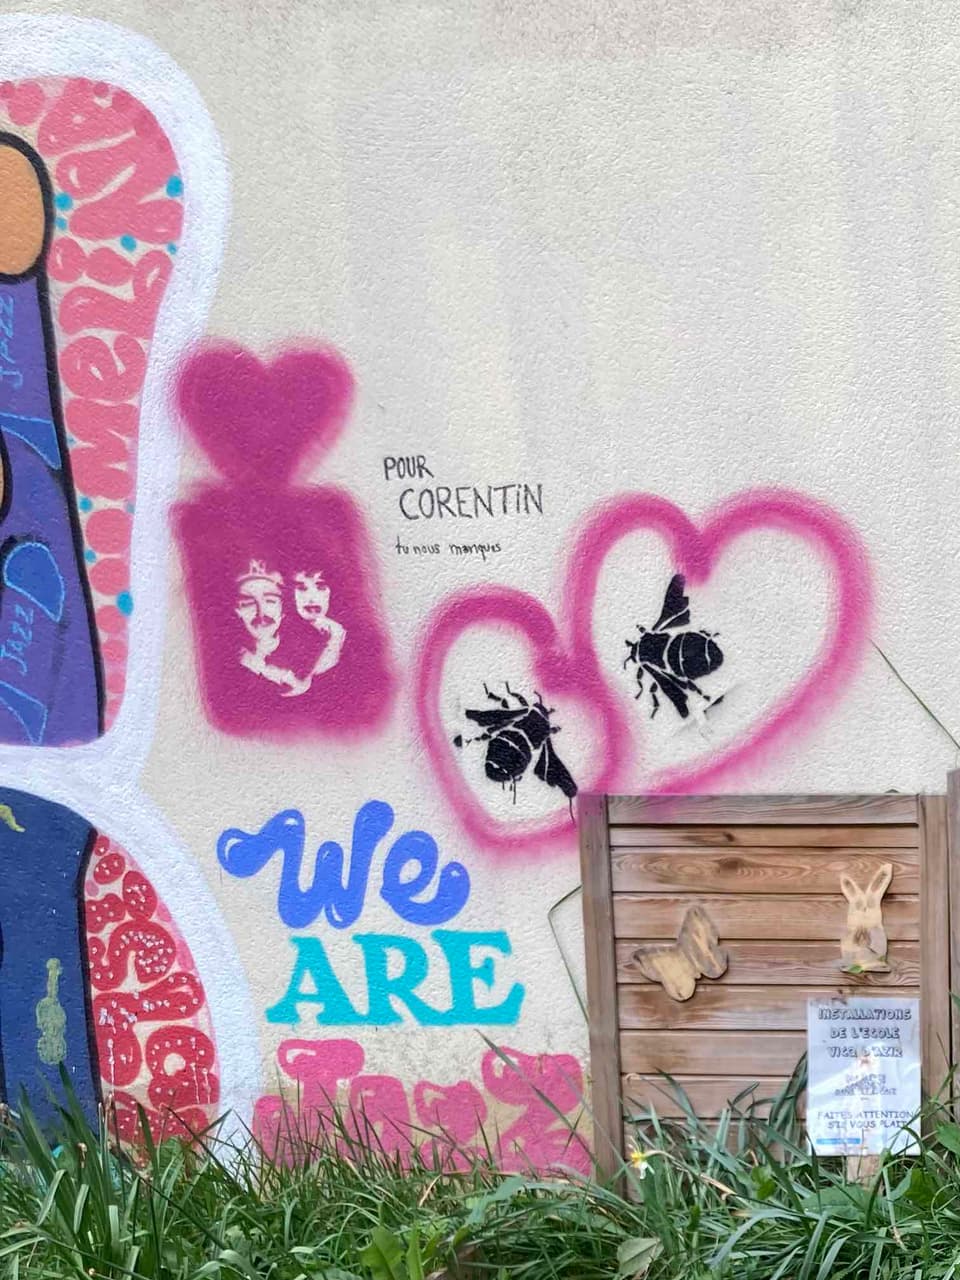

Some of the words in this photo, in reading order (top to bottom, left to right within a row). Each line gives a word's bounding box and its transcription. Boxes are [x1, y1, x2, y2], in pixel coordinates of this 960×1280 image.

[383, 455, 435, 481] POUR
[395, 536, 409, 555] tu
[412, 543, 441, 555] nous
[449, 543, 502, 562] manques
[217, 800, 471, 930] We
[264, 929, 526, 1026] ARE
[818, 1008, 912, 1020] INSTALLATIONS
[831, 1027, 847, 1039] DE
[849, 1120, 876, 1129] VOUS
[856, 1110, 914, 1120] ATTENTION
